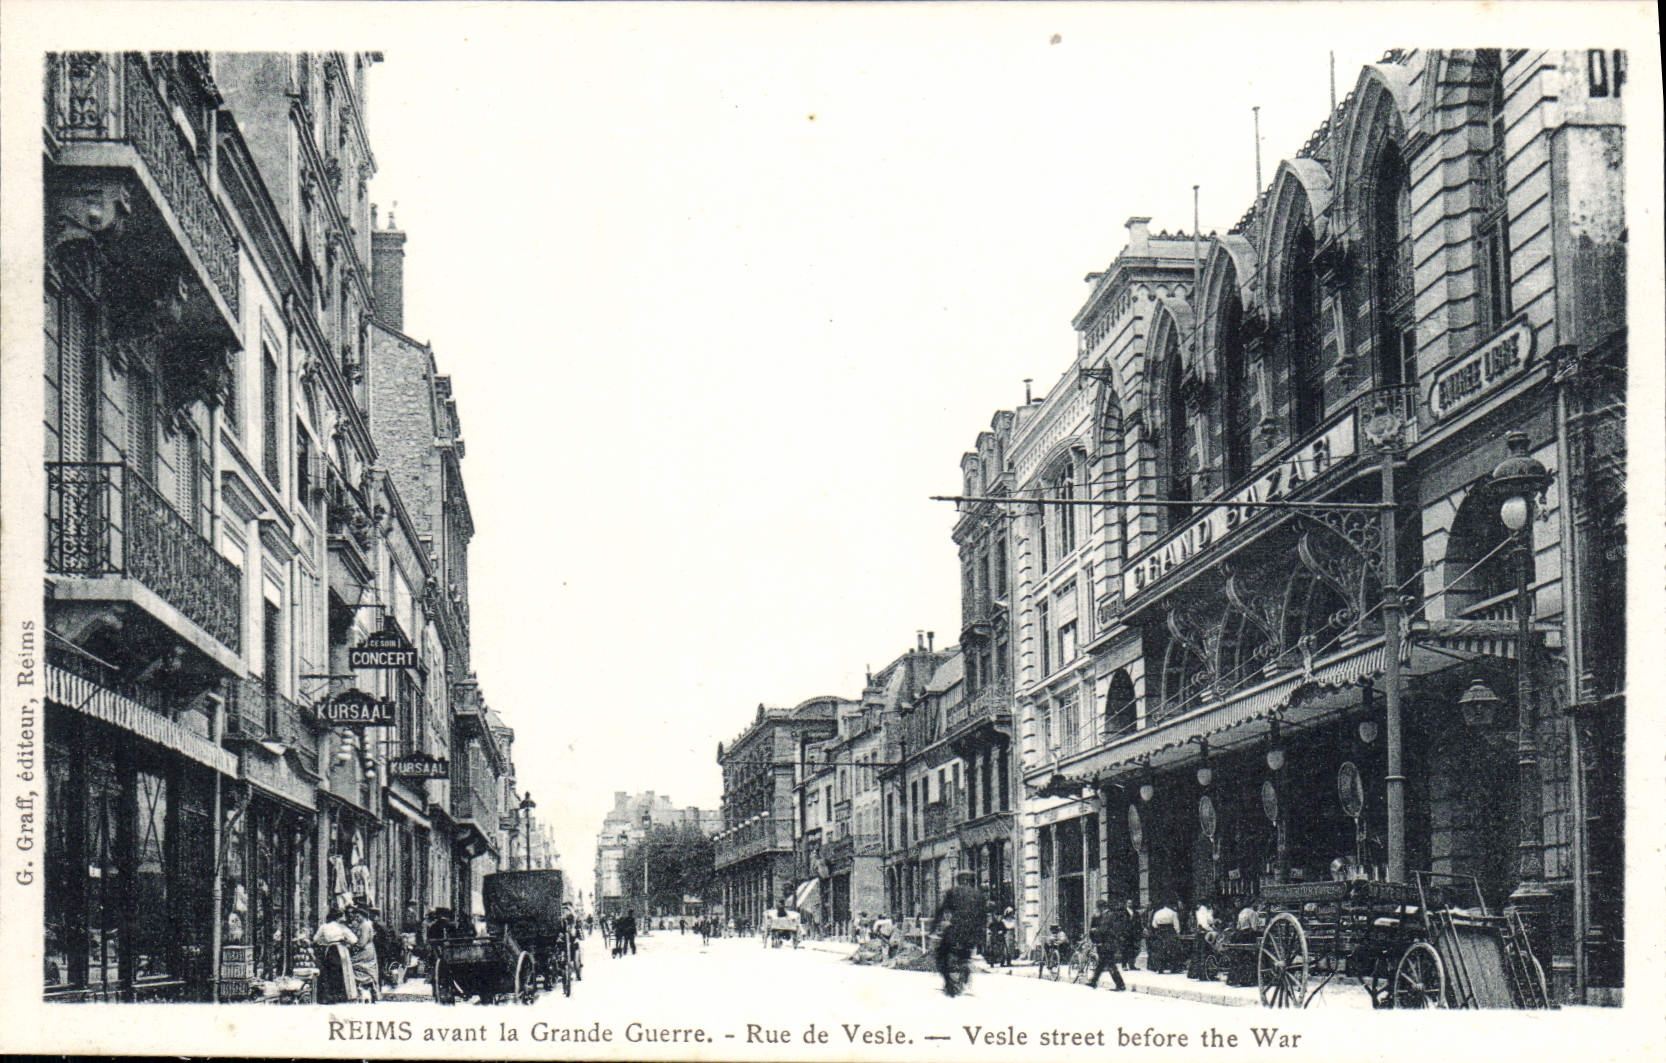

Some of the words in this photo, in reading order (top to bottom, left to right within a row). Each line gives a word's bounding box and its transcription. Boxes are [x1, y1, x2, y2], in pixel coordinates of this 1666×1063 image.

[1133, 519, 1213, 590] GRAND
[1225, 434, 1331, 529] BAZAR
[352, 652, 414, 665] CONCERT
[317, 704, 391, 719] KURSAAL
[390, 762, 446, 774] KURSAAL
